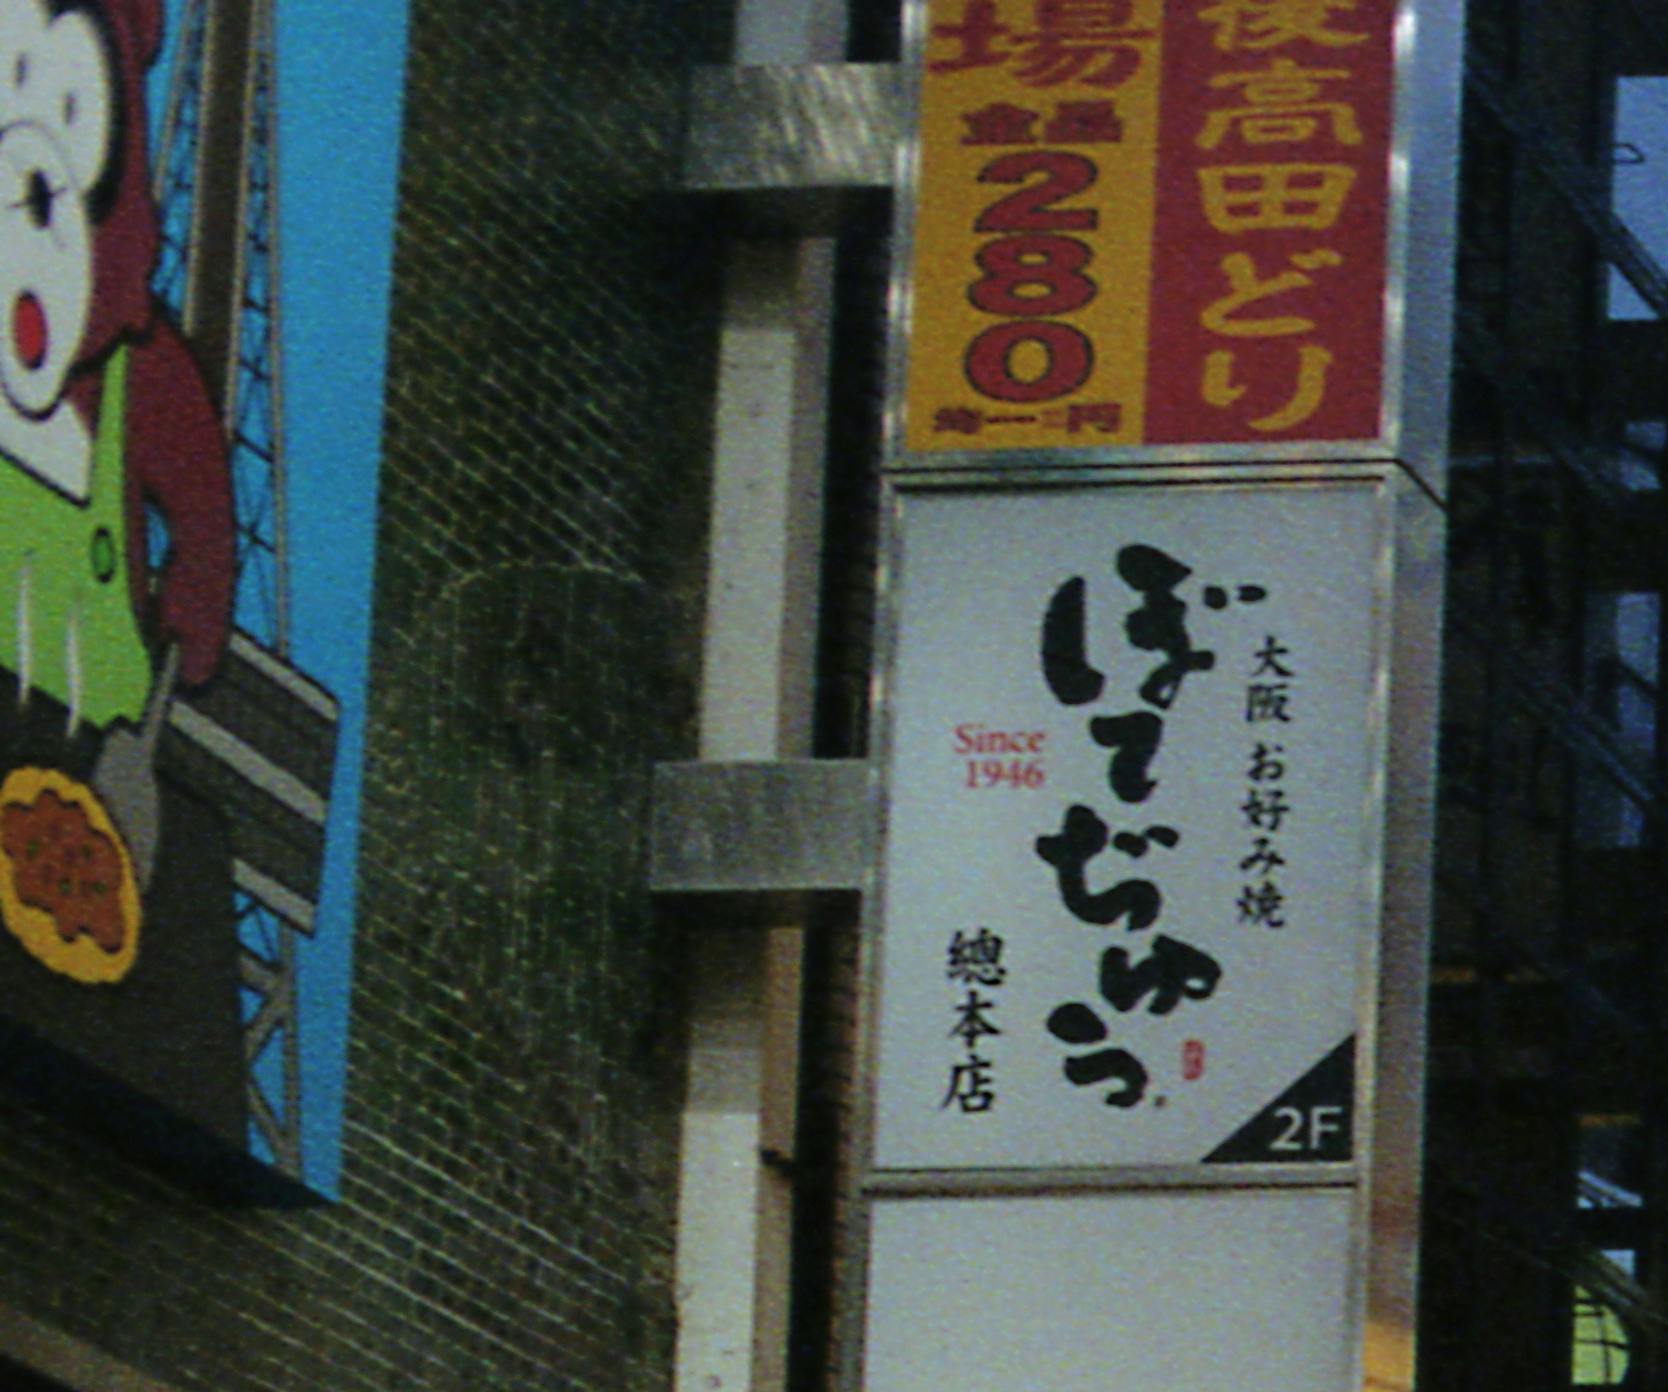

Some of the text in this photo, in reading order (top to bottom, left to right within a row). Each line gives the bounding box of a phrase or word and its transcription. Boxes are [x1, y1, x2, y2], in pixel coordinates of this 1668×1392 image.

[964, 150, 1098, 403] 280
[954, 725, 1045, 756] Since
[964, 760, 1044, 789] 1946
[1235, 635, 1294, 929] 大阪 お好み焼
[1270, 1106, 1343, 1150] 2F
